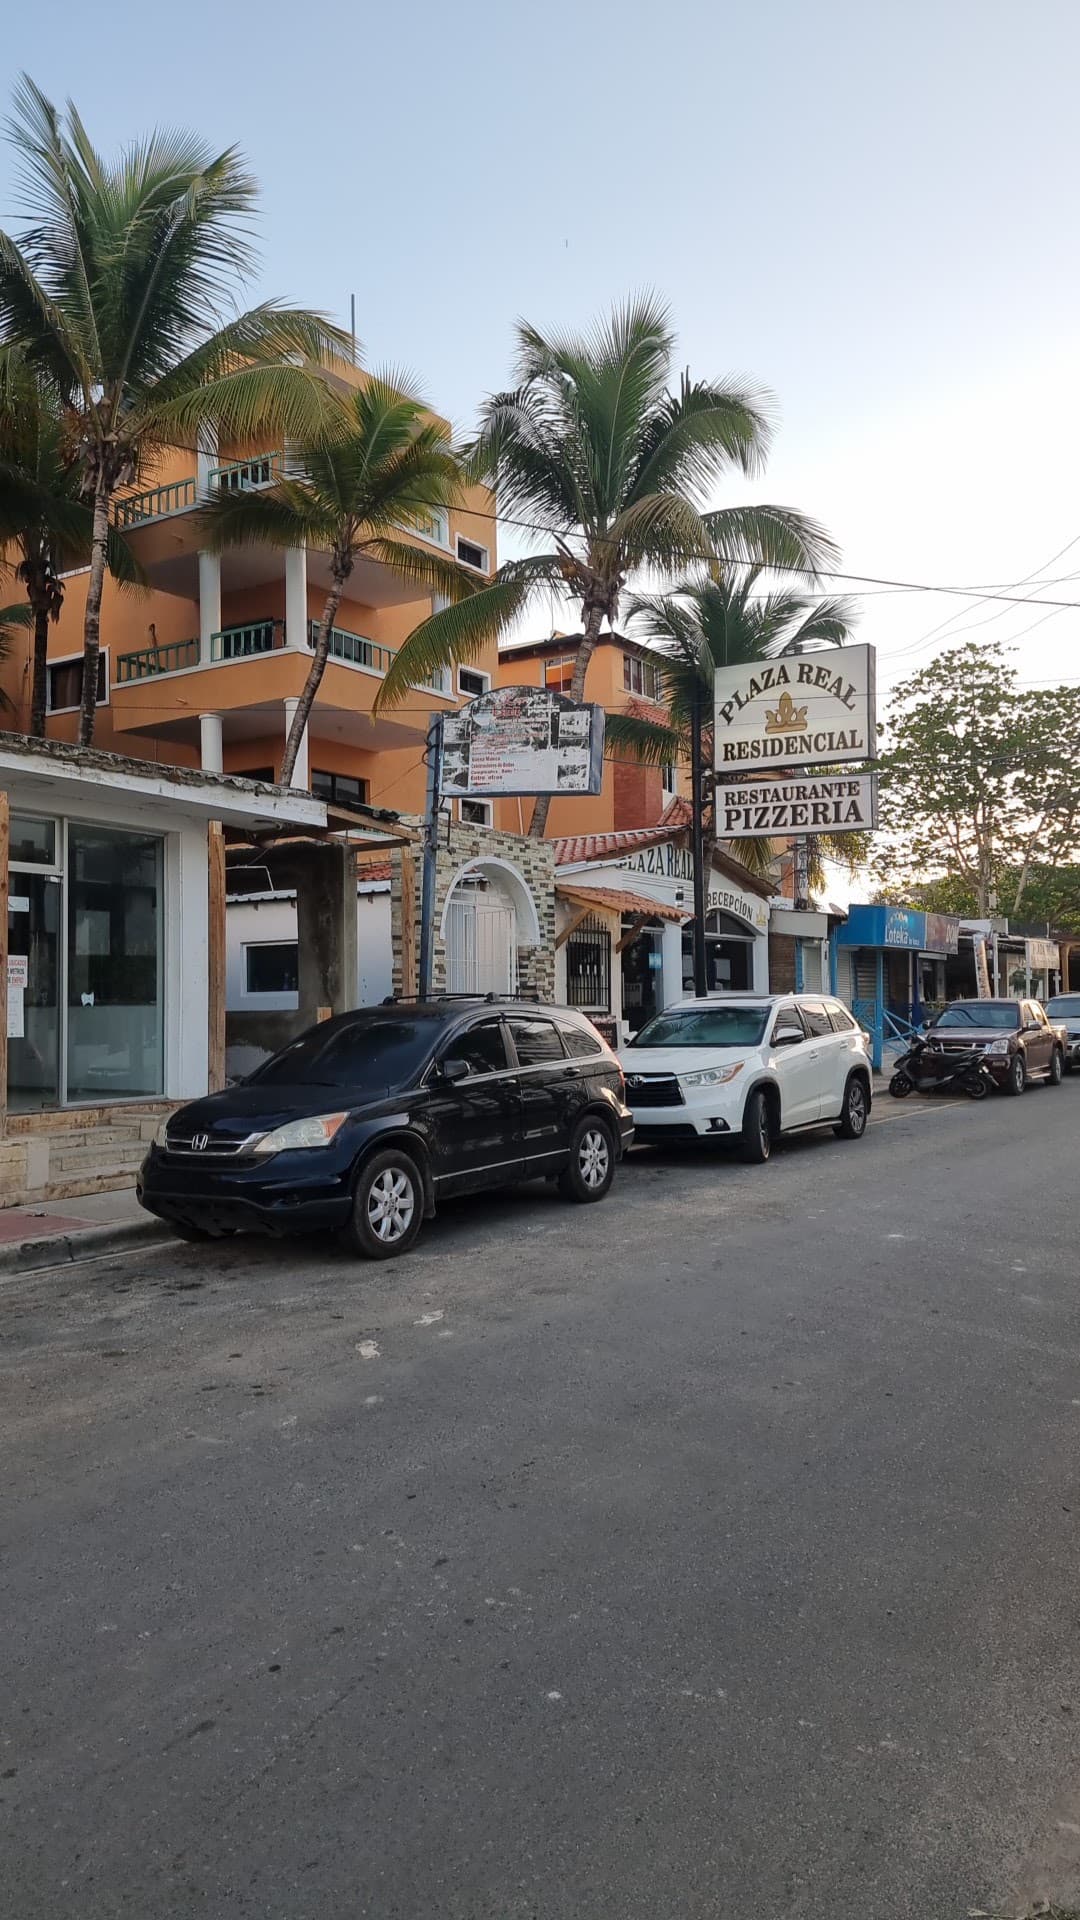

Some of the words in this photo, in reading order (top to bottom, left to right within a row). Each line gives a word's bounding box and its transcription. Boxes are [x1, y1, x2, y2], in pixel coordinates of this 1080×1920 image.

[719, 664, 791, 726] PLAZA
[796, 663, 857, 711] REAL
[722, 729, 863, 762] RESIDENCIAL
[724, 781, 860, 806] RESTAURANTE
[724, 800, 864, 831] PIZZERIA
[666, 843, 694, 880] REAL
[884, 923, 909, 945] Loteka
